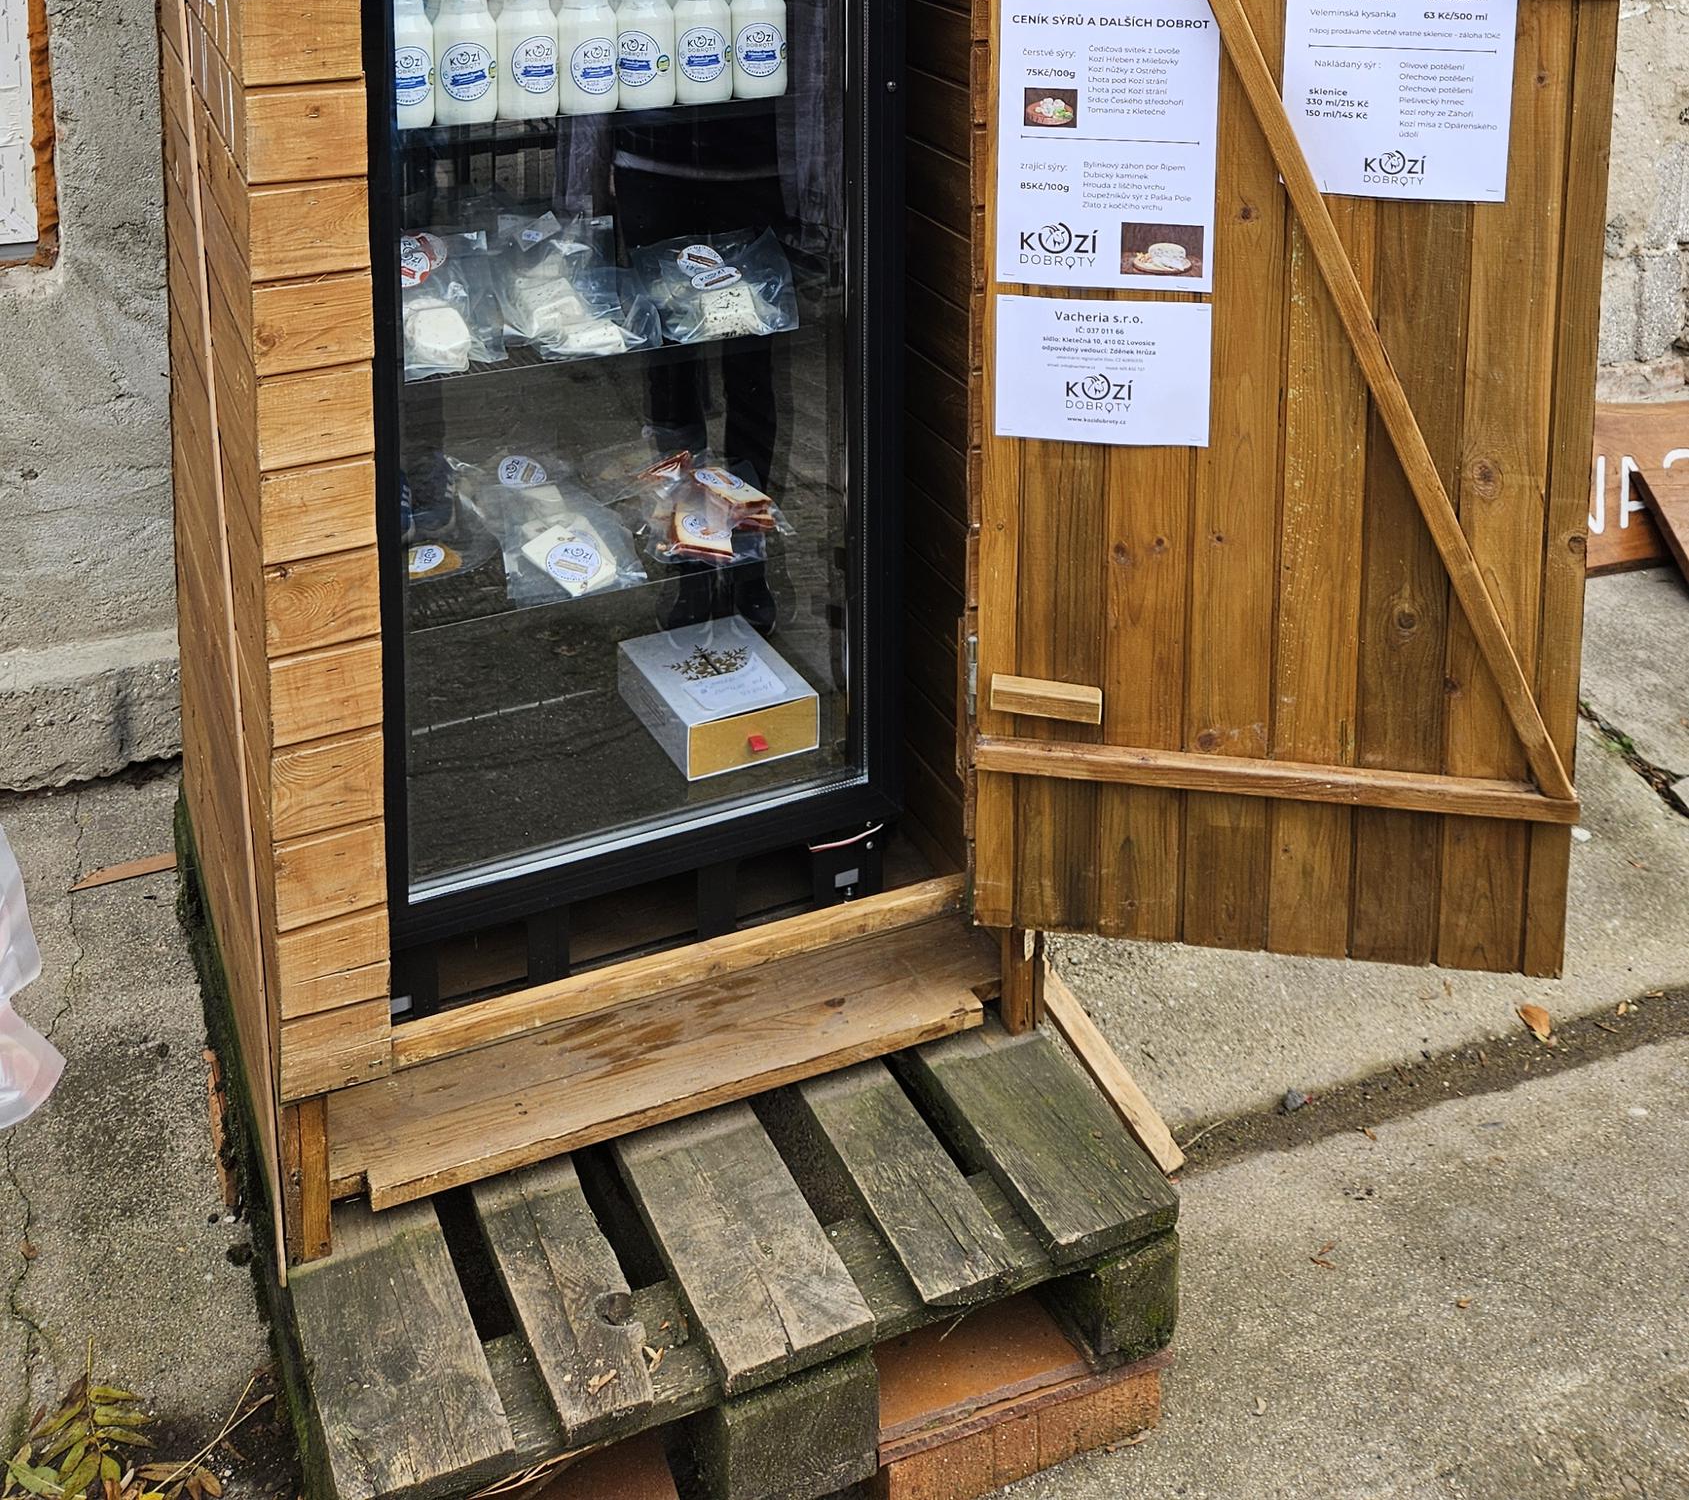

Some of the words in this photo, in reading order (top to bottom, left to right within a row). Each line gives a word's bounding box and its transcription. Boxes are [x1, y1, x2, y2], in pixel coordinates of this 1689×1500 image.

[1013, 14, 1048, 25] CENÍK
[1052, 13, 1083, 26] SÝRŮ
[1088, 17, 1096, 26] A
[1100, 15, 1152, 27] DALŠÍCH
[1156, 19, 1209, 29] DOBROT
[1361, 10, 1396, 19] kysanka
[1424, 12, 1435, 20] 63
[1438, 12, 1472, 21] Kč/500
[1475, 13, 1487, 21] ml
[688, 35, 716, 47] KOZÍ
[746, 31, 774, 43] KOZÍ
[525, 44, 552, 57] KOZÍ
[622, 39, 649, 51] KOZÍ
[584, 46, 610, 58] KOZÍ
[1023, 48, 1053, 57] čerstvé
[1055, 48, 1076, 59] sýry:
[450, 51, 480, 66] KOZÍ
[1315, 60, 1362, 69] Nakládaný
[1364, 61, 1376, 69] sýr
[1400, 62, 1429, 70] Olivové
[1026, 68, 1076, 79] 75Kč/100g
[1400, 74, 1437, 82] Ořechové
[1112, 88, 1126, 96] pod
[1309, 88, 1348, 96] sklenice
[1399, 85, 1436, 93] Ořechové
[1306, 98, 1323, 106] 330
[1325, 99, 1355, 108] ml/215
[1358, 99, 1369, 108] Kč
[1322, 110, 1353, 119] ml/145
[1355, 111, 1368, 120] Kč
[1418, 110, 1436, 119] rohy
[1020, 162, 1046, 171] zrající
[1047, 163, 1067, 172] sýry:
[1364, 150, 1427, 175] KOZÍ
[1363, 174, 1424, 187] DOBROTY
[1020, 182, 1070, 193] 85Kč/100g
[1020, 222, 1099, 254] KOZÍ
[1019, 254, 1096, 269] DOBROTY
[1055, 311, 1109, 323] Vacheria
[1113, 315, 1143, 324] s.r.o.
[1066, 373, 1133, 401] KOZÍ
[1065, 400, 1131, 413] DOBROTY
